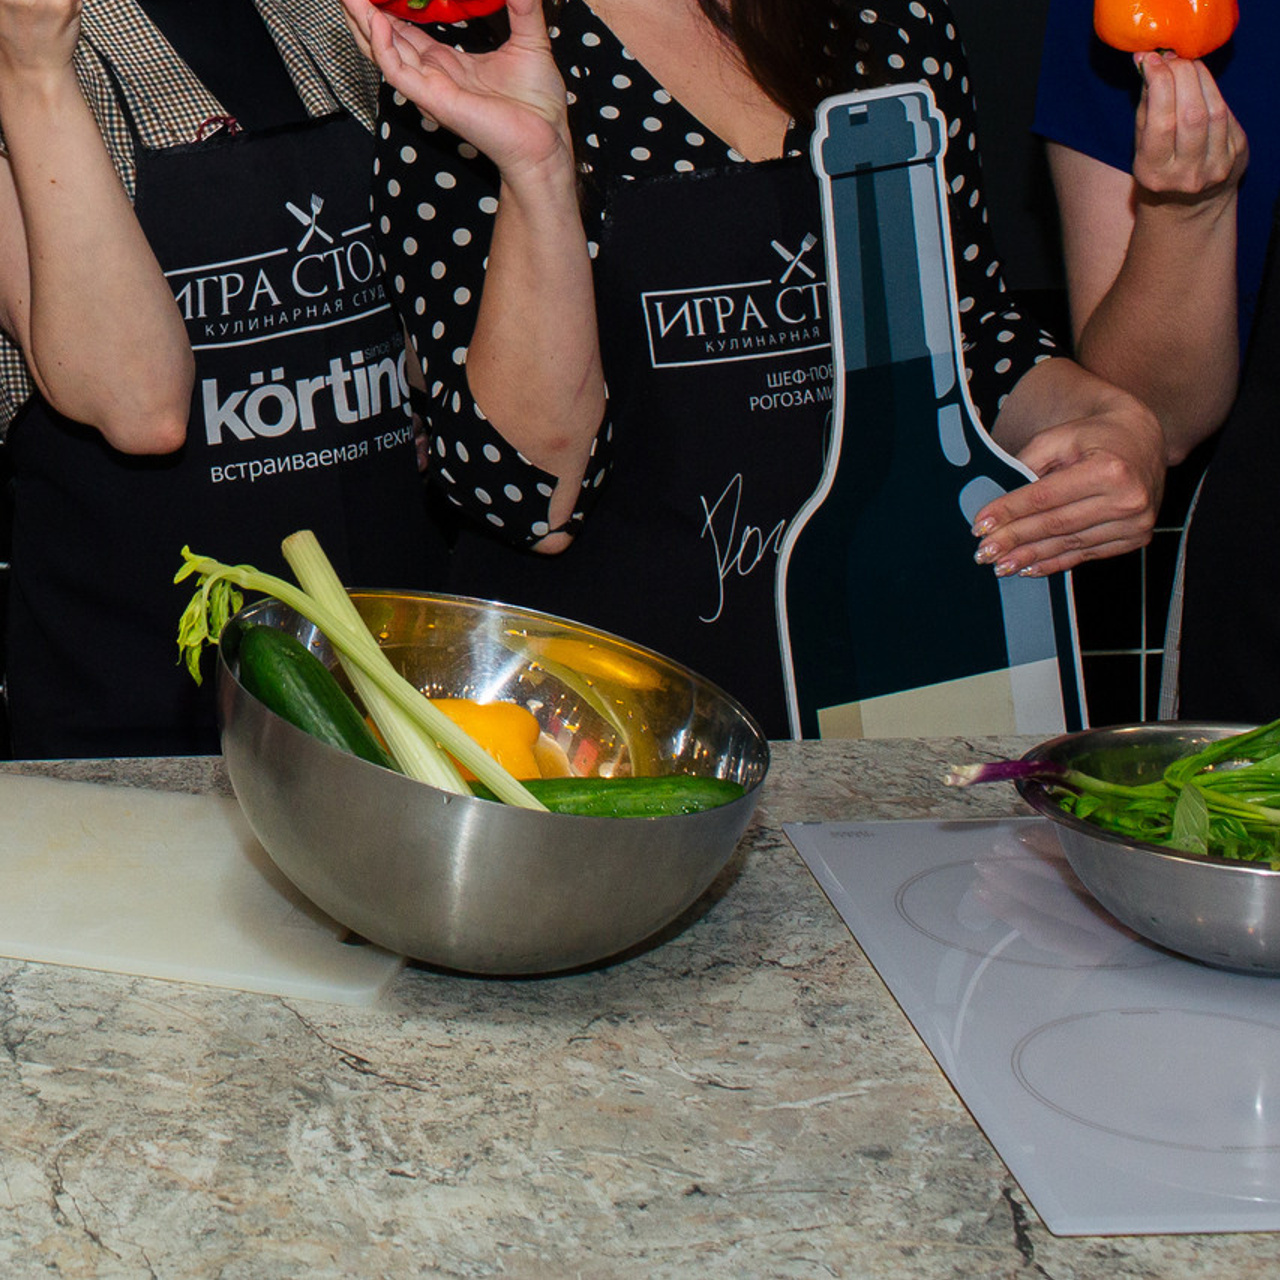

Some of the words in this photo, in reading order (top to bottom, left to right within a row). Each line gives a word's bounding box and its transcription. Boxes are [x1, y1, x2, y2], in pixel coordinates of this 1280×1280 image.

[291, 240, 381, 298] СТО
[204, 299, 343, 337] КУЛИНАРНАЯ
[352, 283, 386, 307] СТУД
[653, 293, 769, 338] ИГРА
[775, 281, 827, 324] СТ
[705, 325, 820, 353] КУЛИНАРНАЯ
[749, 388, 815, 411] РОГОЗА
[210, 439, 369, 483] встраиваемая
[373, 424, 413, 452] техн
